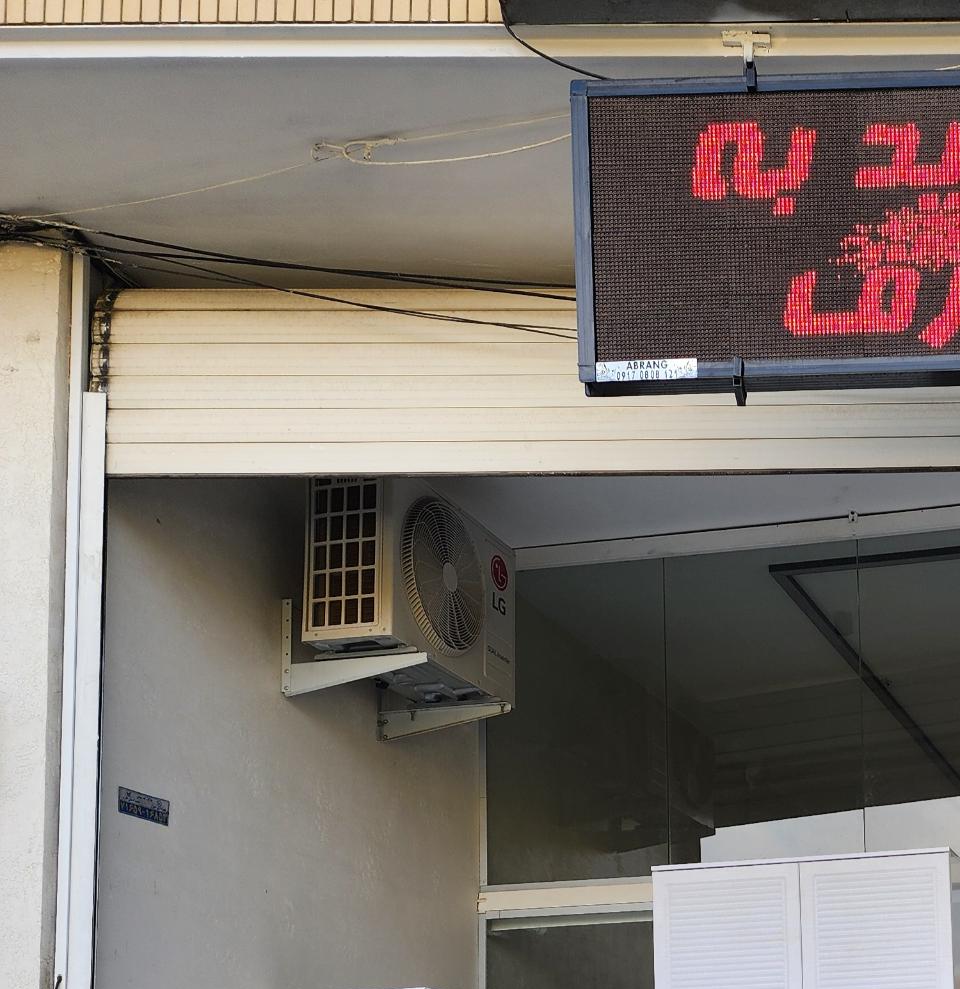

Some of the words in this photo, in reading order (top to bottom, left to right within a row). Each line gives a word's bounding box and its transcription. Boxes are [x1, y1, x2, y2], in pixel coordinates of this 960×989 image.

[691, 120, 816, 216] به
[626, 361, 668, 370] ABRANG
[616, 371, 636, 381] 0917
[492, 591, 506, 615] LG
